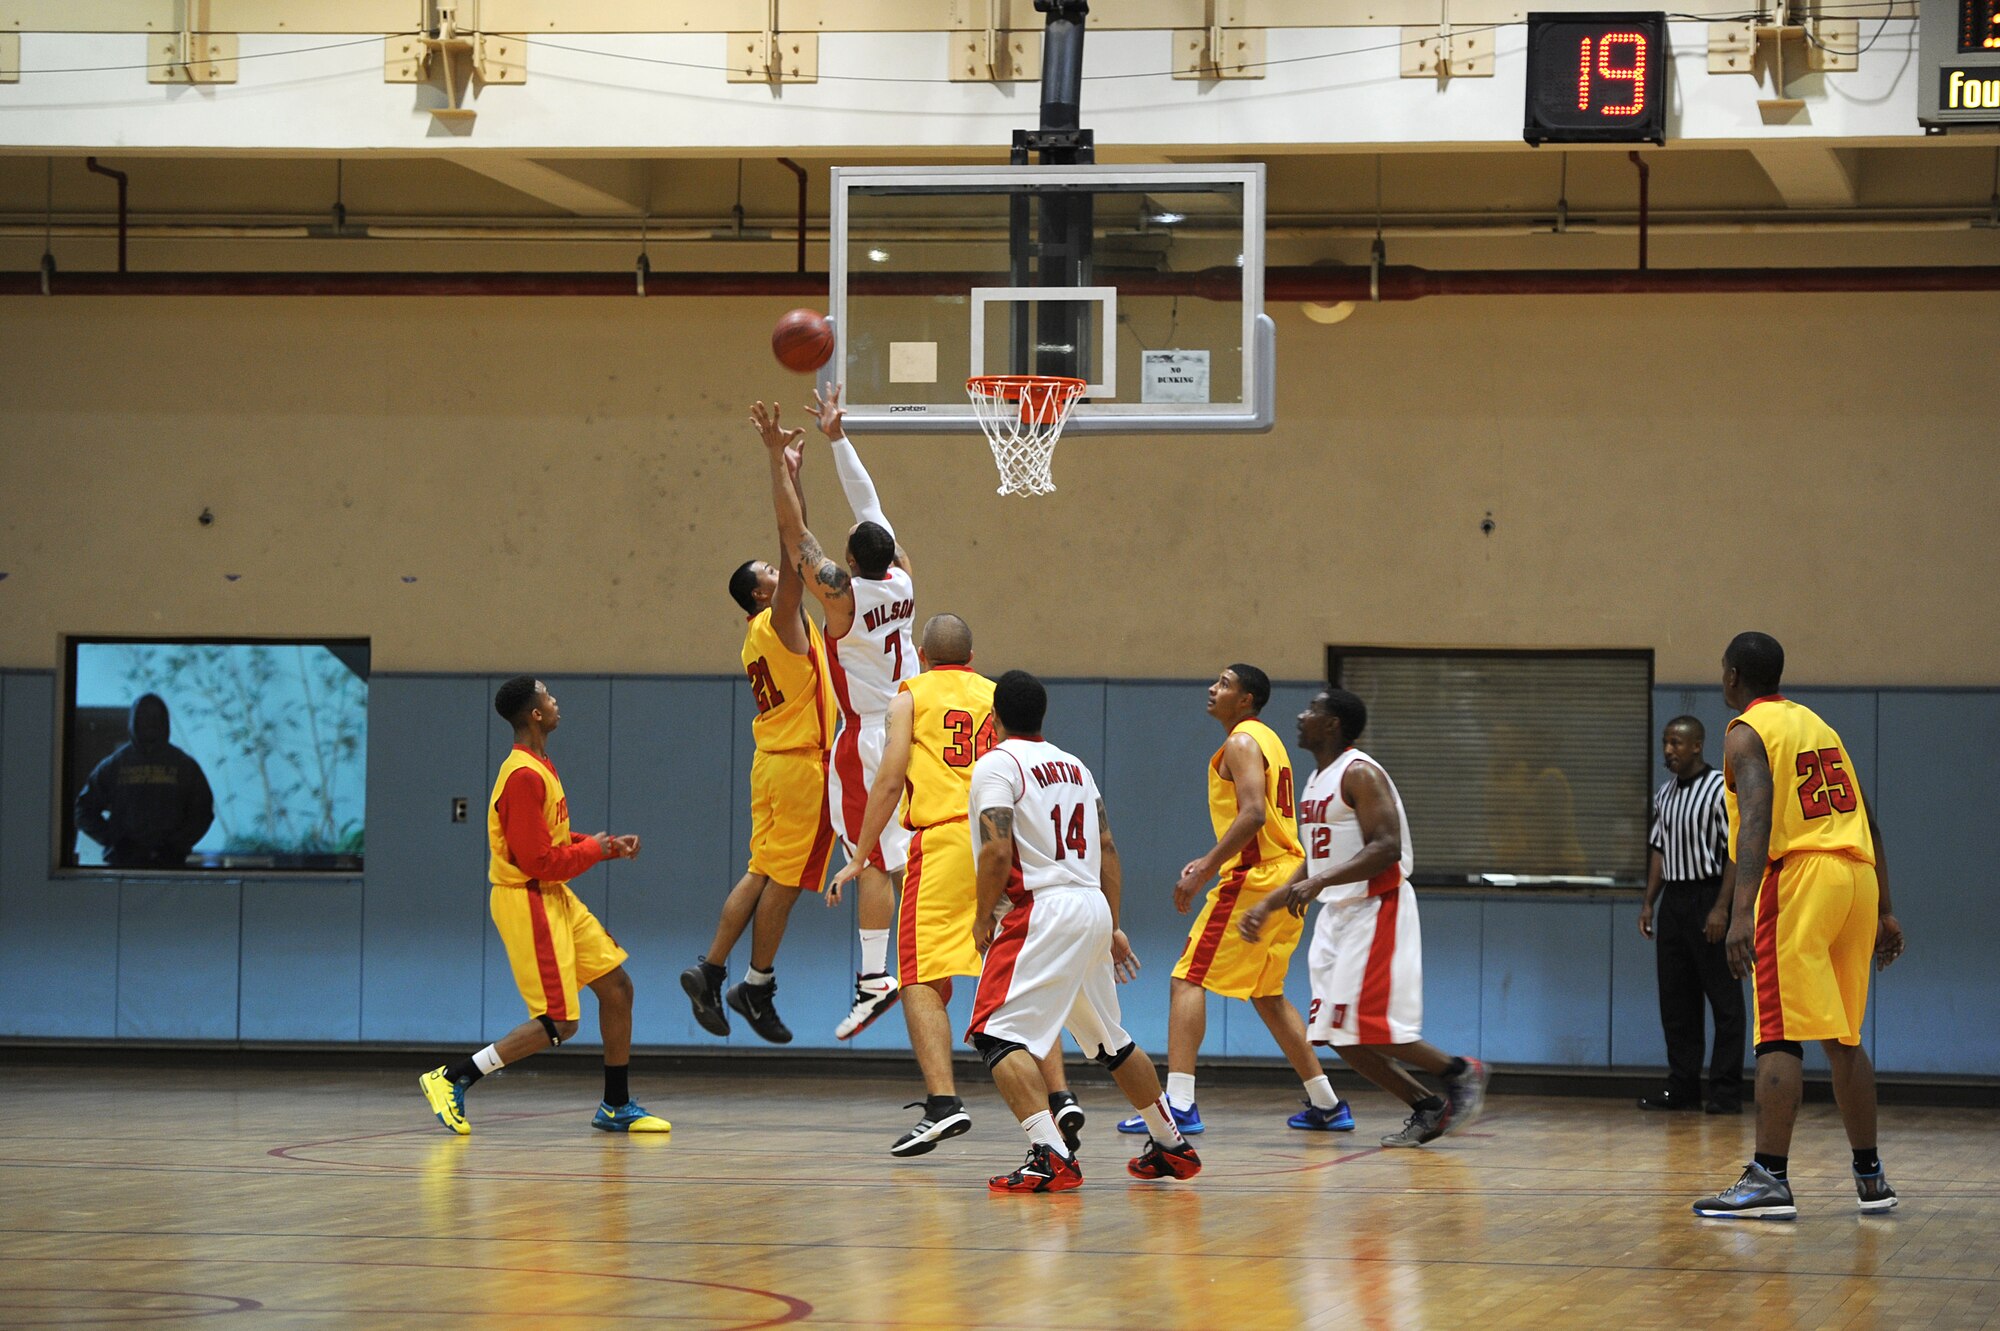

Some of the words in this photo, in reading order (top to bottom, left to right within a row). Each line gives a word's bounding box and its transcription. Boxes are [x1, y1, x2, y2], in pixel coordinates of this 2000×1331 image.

[1578, 32, 1646, 115] 19
[1949, 71, 2000, 108] fou
[890, 405, 926, 413] porter
[863, 598, 914, 633] WILSON
[884, 629, 902, 682] 7
[747, 655, 785, 714] 21
[943, 709, 998, 767] 34
[1031, 761, 1083, 789] MARTIN
[1796, 747, 1857, 820] 25
[1051, 803, 1087, 860] 14
[1312, 827, 1332, 859] 12
